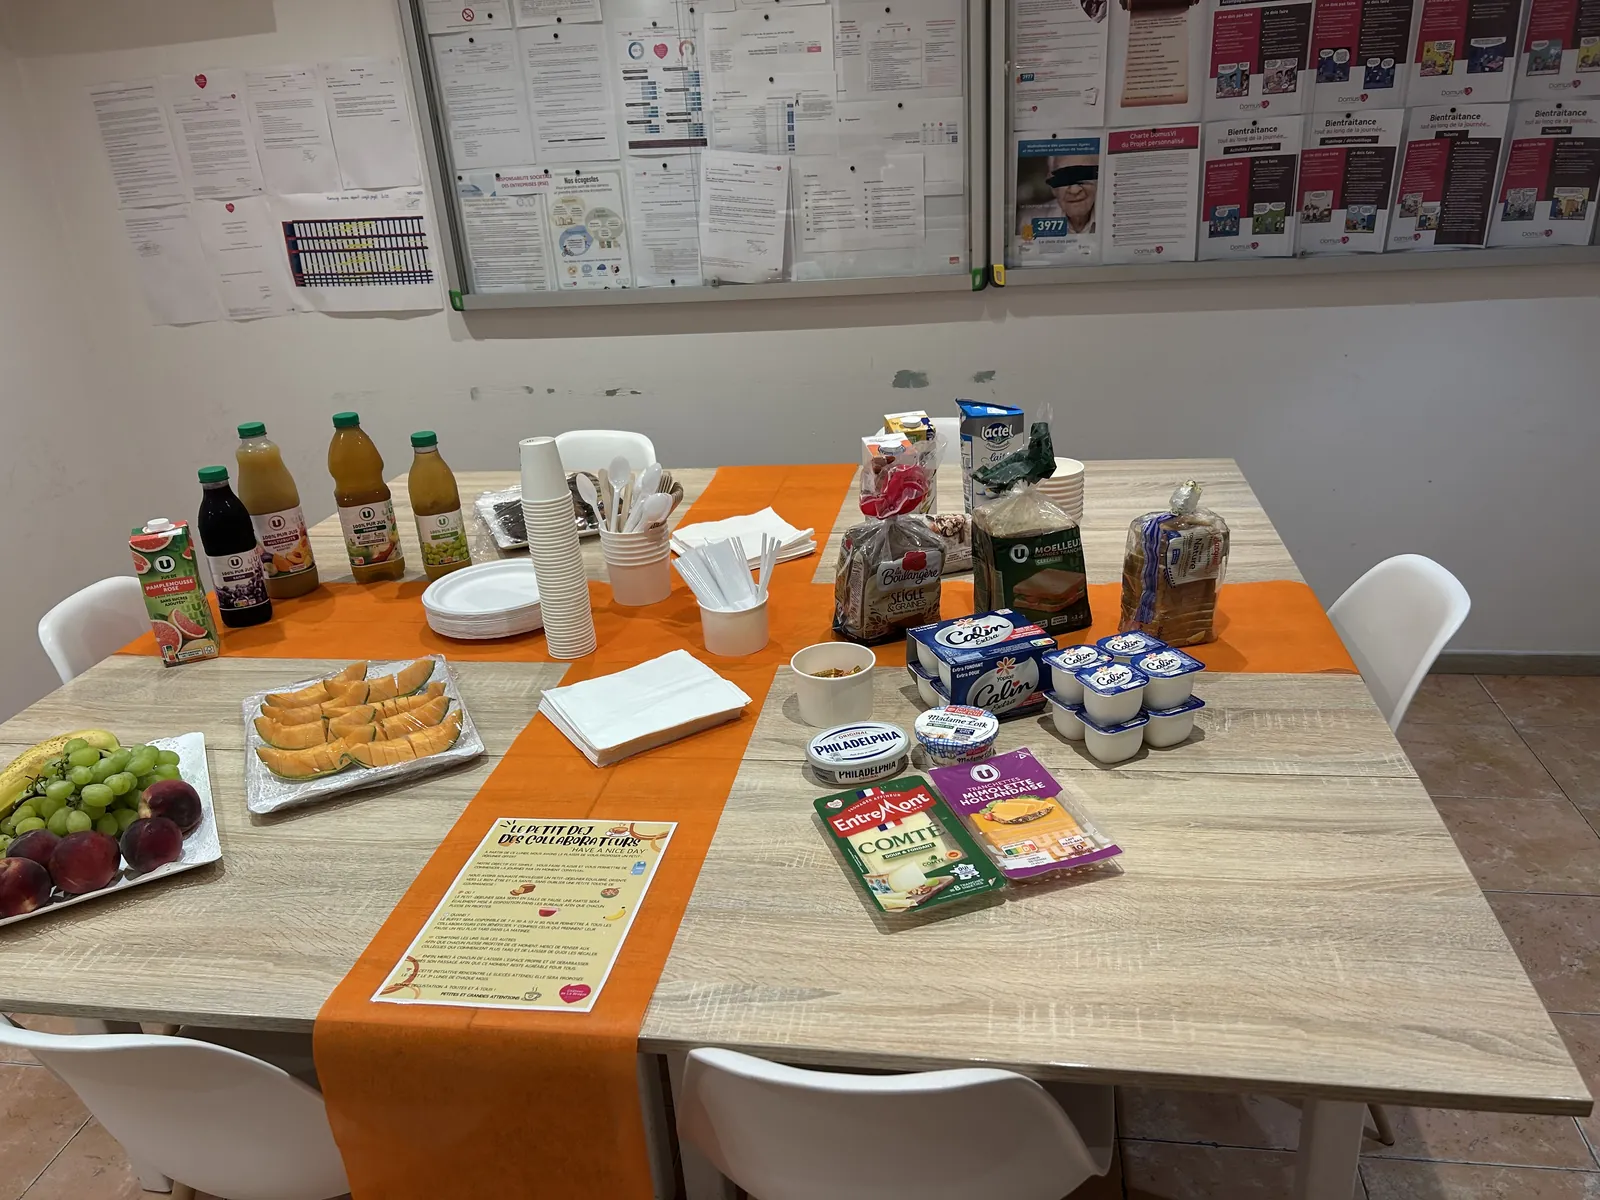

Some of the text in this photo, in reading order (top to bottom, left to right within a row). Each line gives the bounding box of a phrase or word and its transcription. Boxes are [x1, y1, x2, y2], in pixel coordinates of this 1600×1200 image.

[1325, 119, 1376, 127] Bientraitance
[1429, 113, 1481, 121] Bientraitance
[1227, 126, 1277, 135] Bientraitance
[1148, 138, 1184, 147] personnalisé
[564, 175, 599, 185] Nos écogestes
[1037, 220, 1064, 232] 3977
[1189, 538, 1203, 570] Nature
[882, 568, 939, 586] Boulangère
[145, 578, 193, 591] PAMPLEMOUSSE
[887, 603, 895, 612] &
[895, 600, 926, 611] GRAINES
[945, 623, 1010, 645] Calin
[975, 634, 999, 646] Extra
[1111, 639, 1142, 651] Calin
[1063, 649, 1096, 666] Calin
[964, 662, 984, 670] FONDANT
[1146, 657, 1179, 671] Calin
[1096, 669, 1130, 686] Calin
[972, 679, 1034, 709] Calin
[928, 714, 966, 725] Madame
[838, 730, 868, 739] ORIGINAL
[812, 731, 902, 756] PHILADELPHIA
[838, 761, 896, 779] PHILADELPHIA
[976, 768, 993, 779] U
[962, 779, 1034, 800] MIMOLETTE
[966, 776, 1021, 792] TRANCHETTES
[959, 782, 1046, 806] HOLLANDAISE
[510, 825, 595, 836] LE PETIT DEJ
[498, 834, 641, 848] DES COLLABORATEURS
[858, 822, 946, 855] COMTÉ
[907, 844, 933, 853] FONDANT
